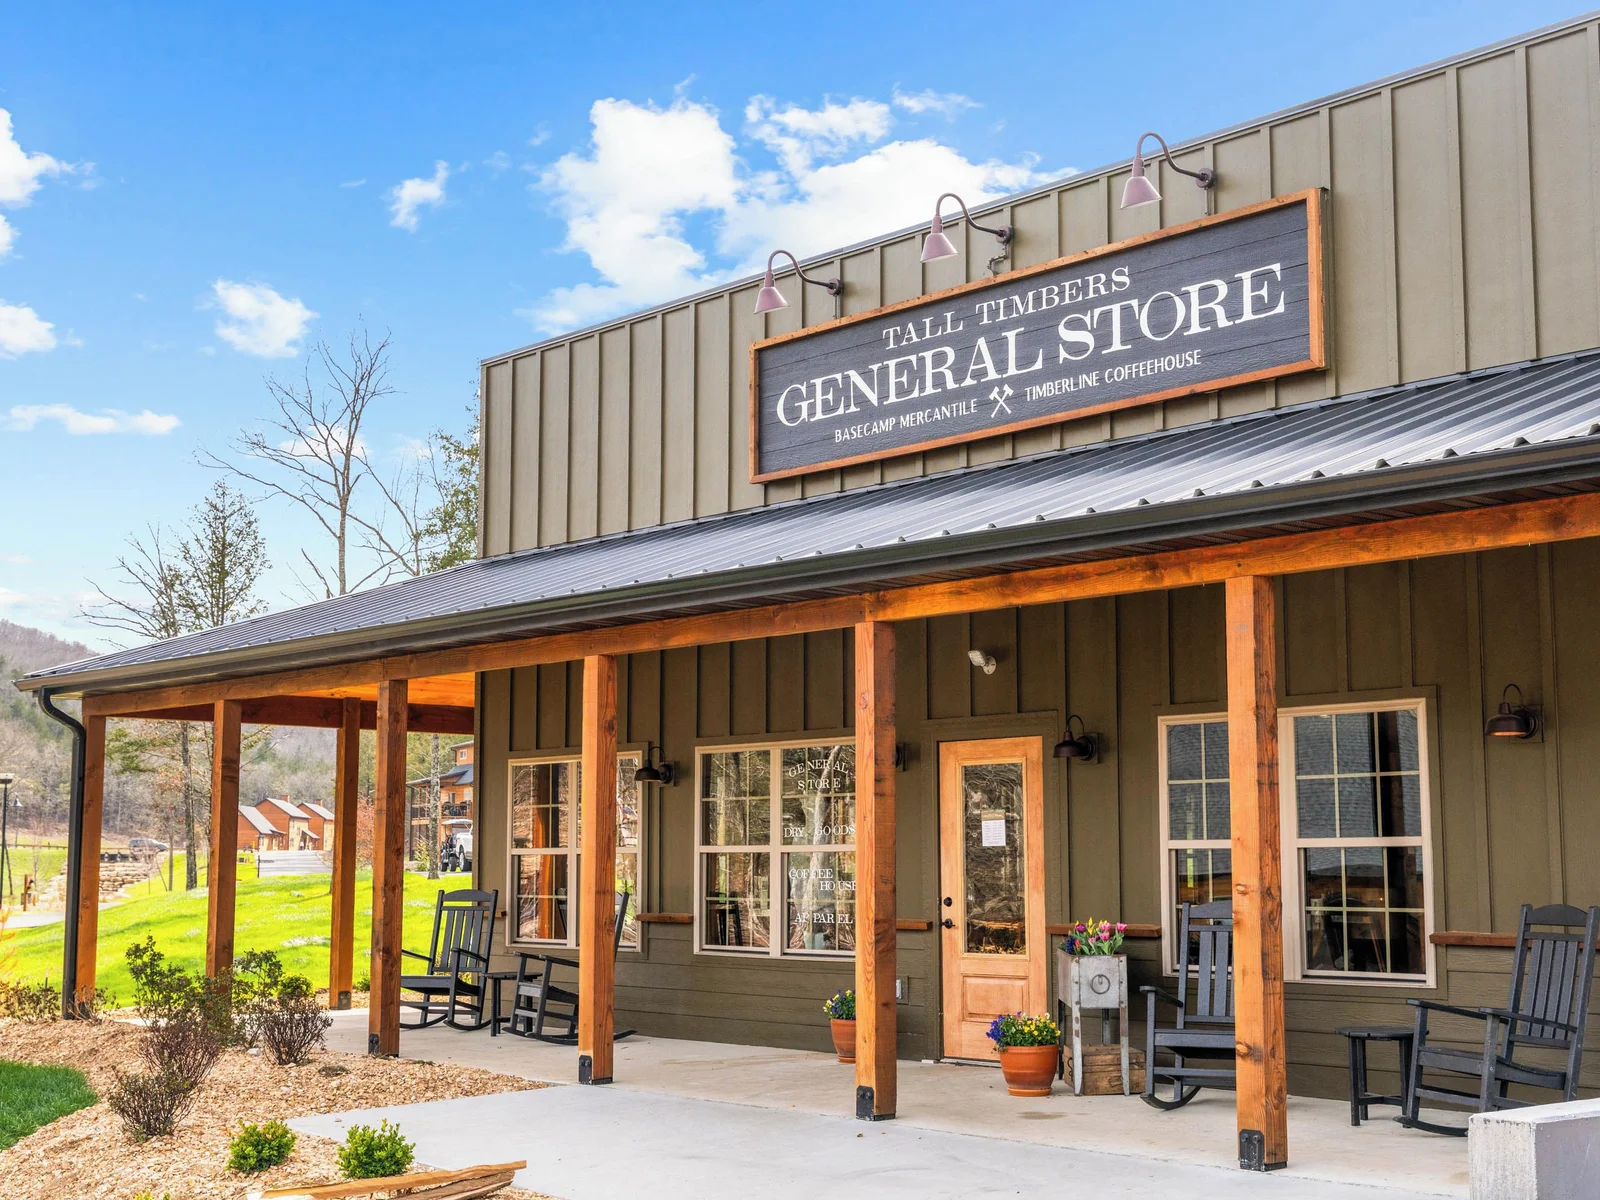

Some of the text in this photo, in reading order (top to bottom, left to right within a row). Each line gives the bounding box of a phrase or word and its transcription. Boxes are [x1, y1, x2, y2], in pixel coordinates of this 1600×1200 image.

[882, 266, 1131, 351] TALL TIMBERS
[775, 262, 1286, 427] GENERAL STORE
[1023, 348, 1202, 402] TIMBERLINE COFFEEHOUSE
[834, 397, 978, 444] BASECAMP MERCANTILE
[788, 759, 849, 778] GENERAL
[797, 778, 841, 790] STORE
[784, 825, 856, 838] DRY GOODS
[788, 868, 833, 879] COFFEE
[794, 912, 853, 924] APPAREL
